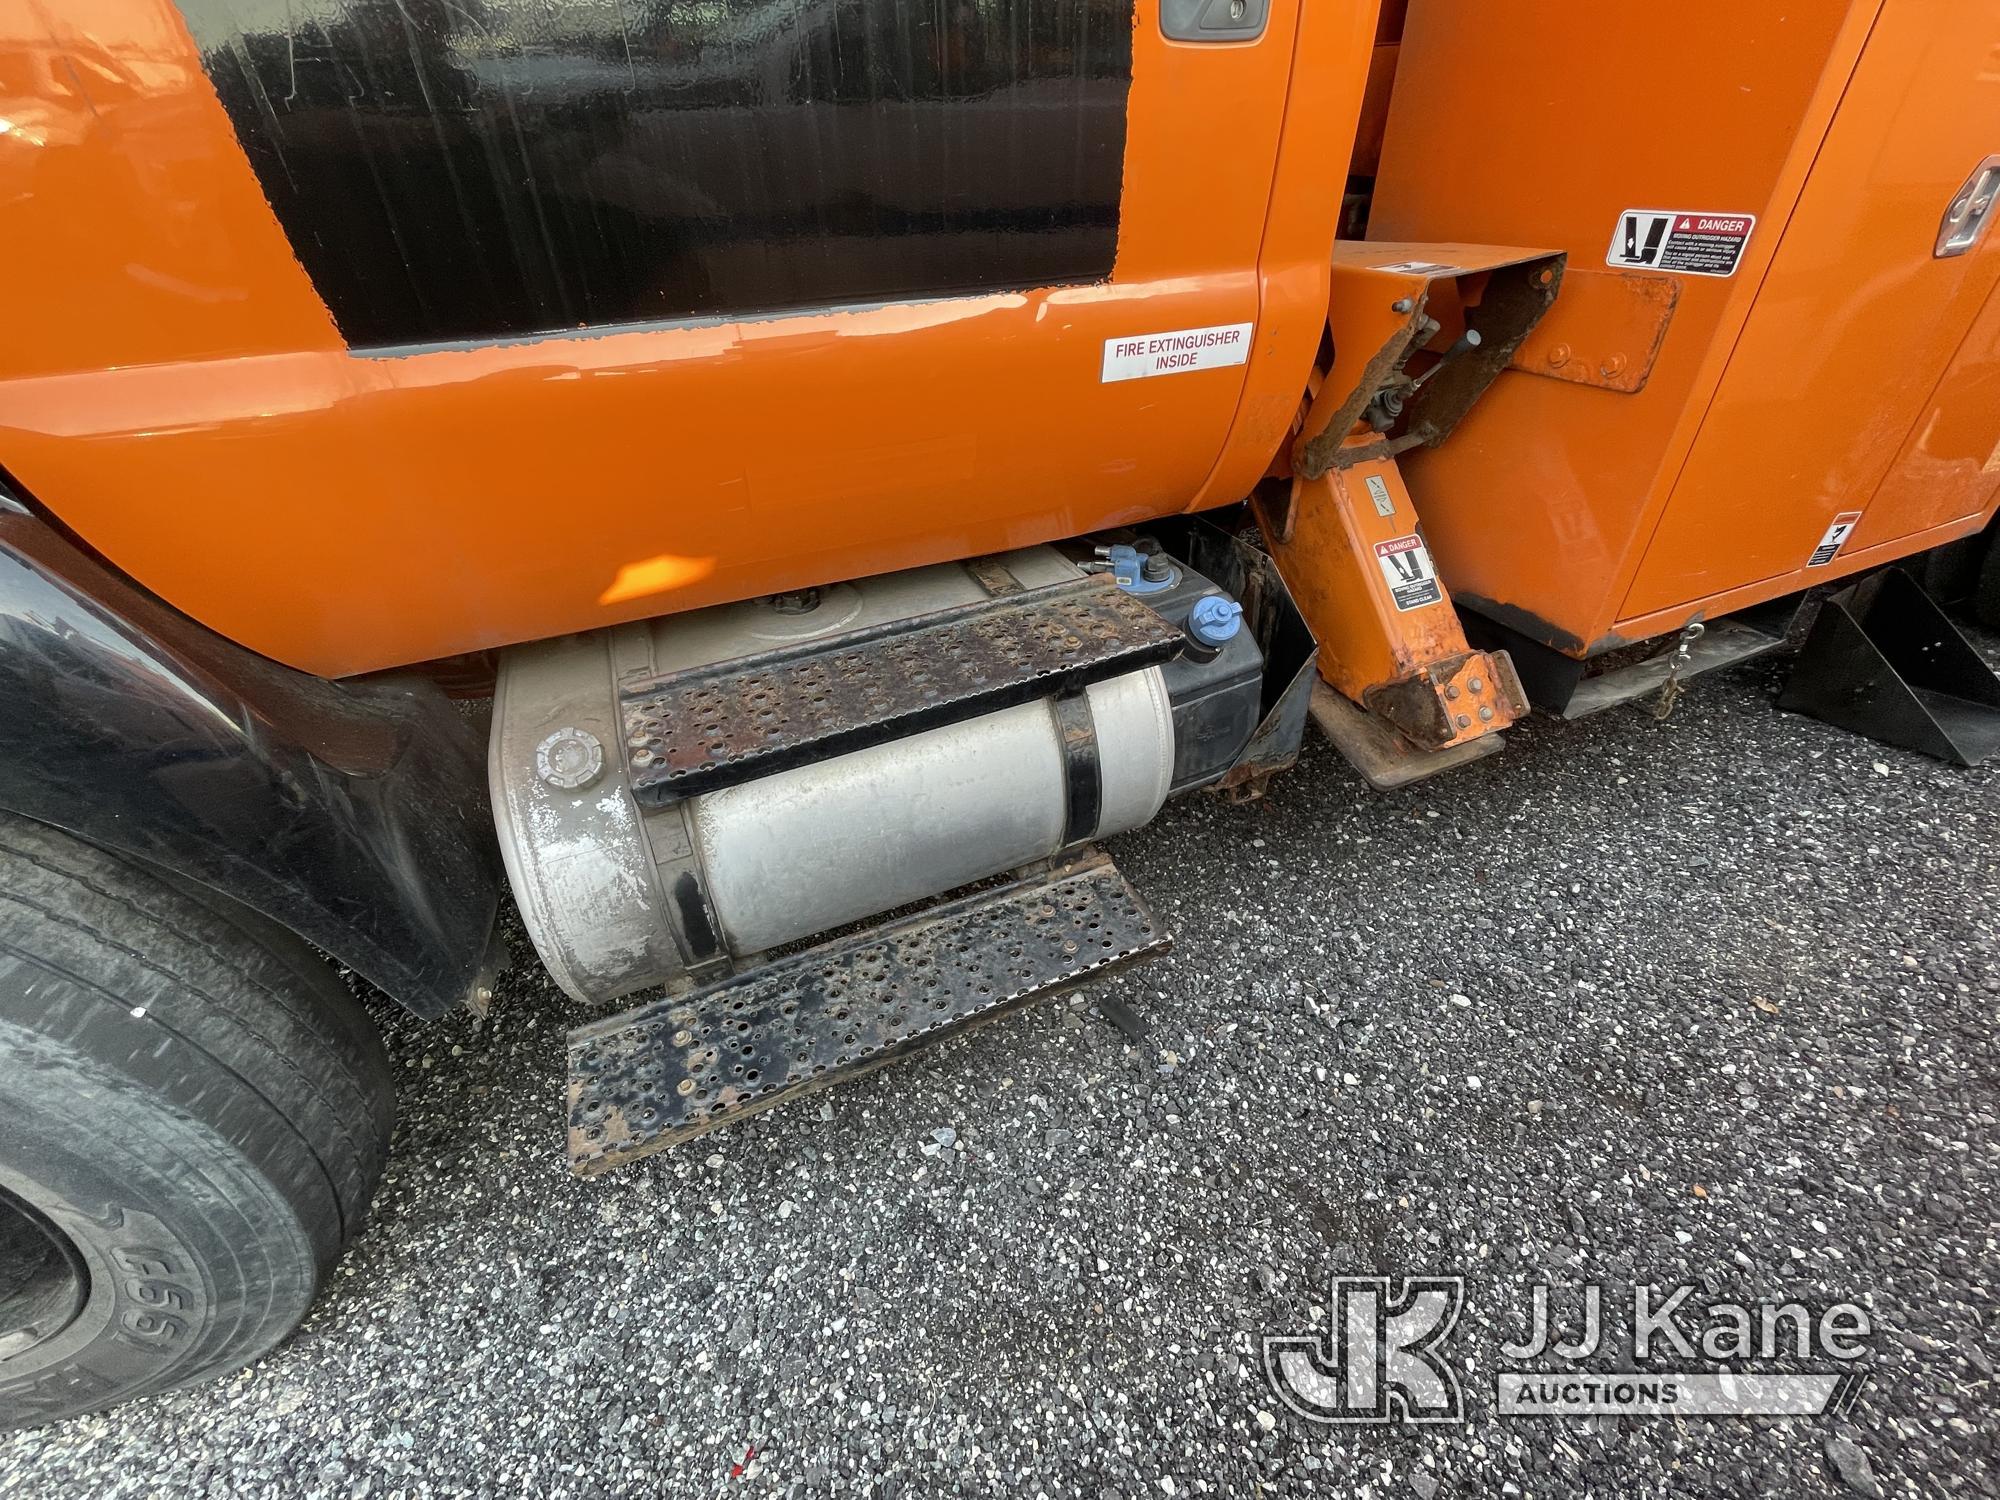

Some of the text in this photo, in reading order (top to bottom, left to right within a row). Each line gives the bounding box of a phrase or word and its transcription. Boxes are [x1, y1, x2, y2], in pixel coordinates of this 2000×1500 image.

[1697, 218, 1744, 231] DANGER
[1115, 330, 1240, 358] FIRE EXTINGUISHER
[1156, 352, 1198, 370] INSIDE
[1388, 539, 1416, 552] DANGER
